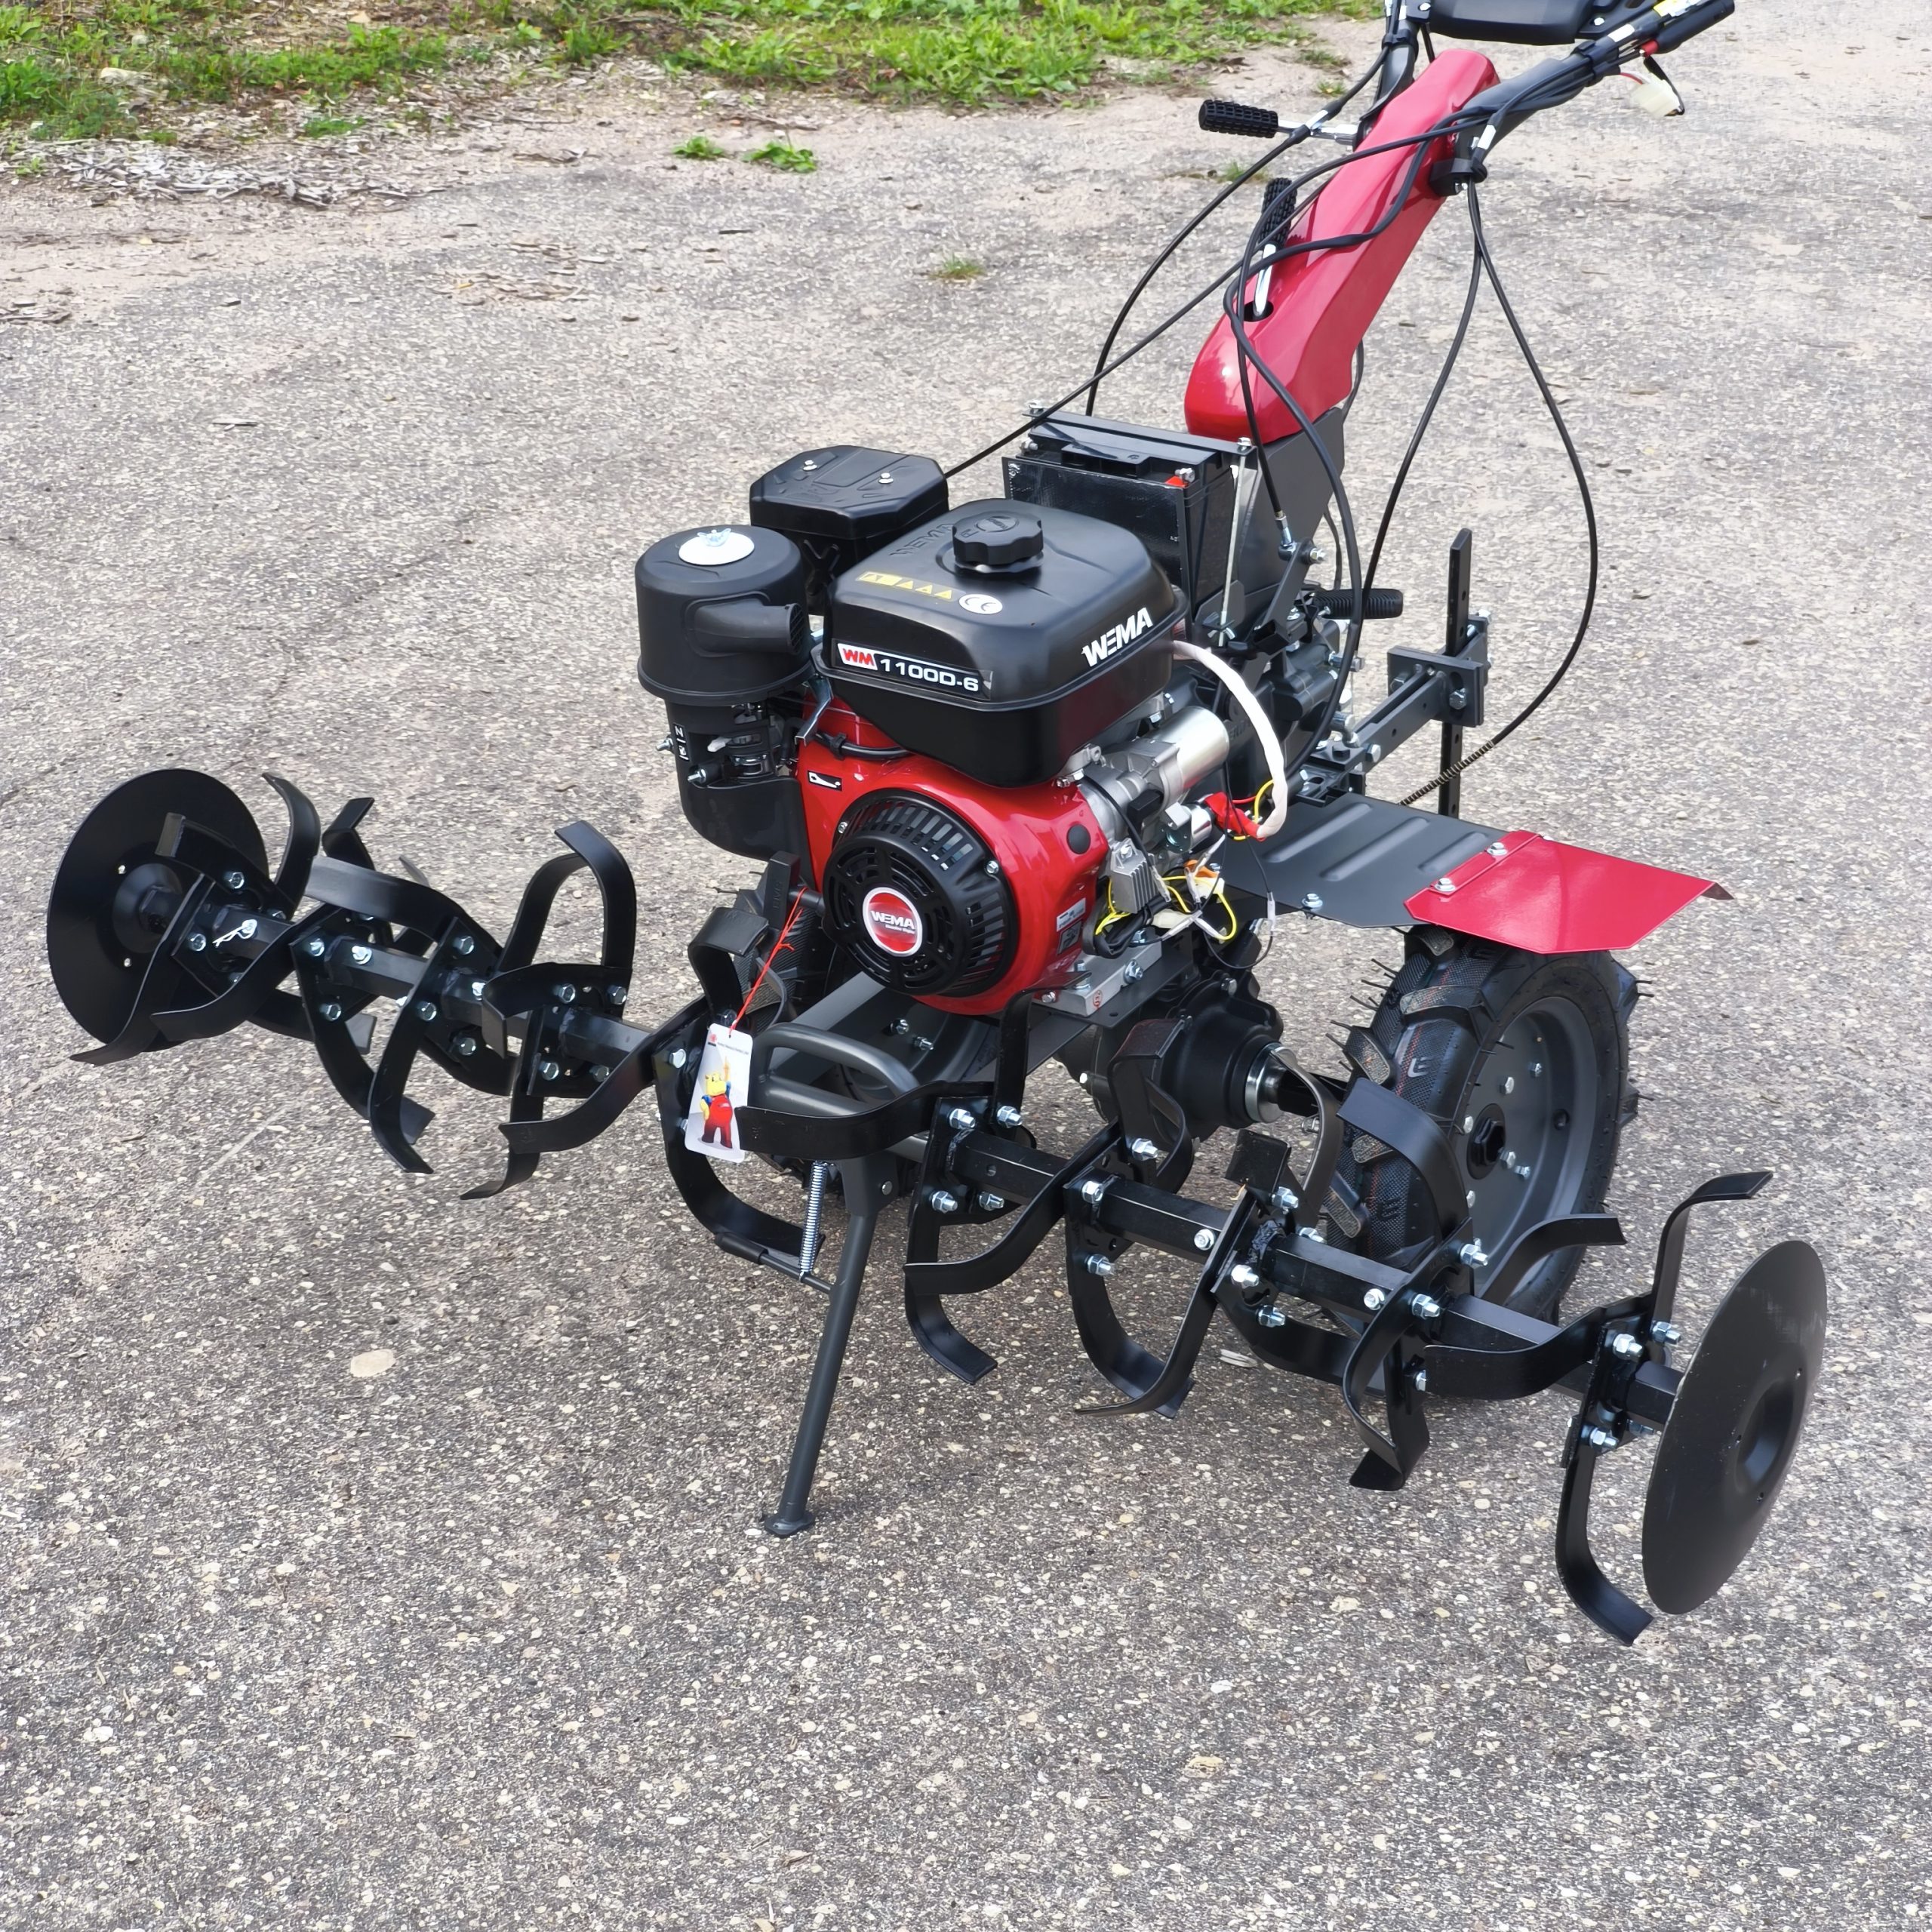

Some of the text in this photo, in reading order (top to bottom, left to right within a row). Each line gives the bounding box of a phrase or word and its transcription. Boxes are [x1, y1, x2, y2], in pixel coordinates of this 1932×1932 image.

[1081, 607, 1153, 667] WEMA
[842, 648, 979, 692] WM 1100D-6
[870, 910, 915, 930] WEMA
